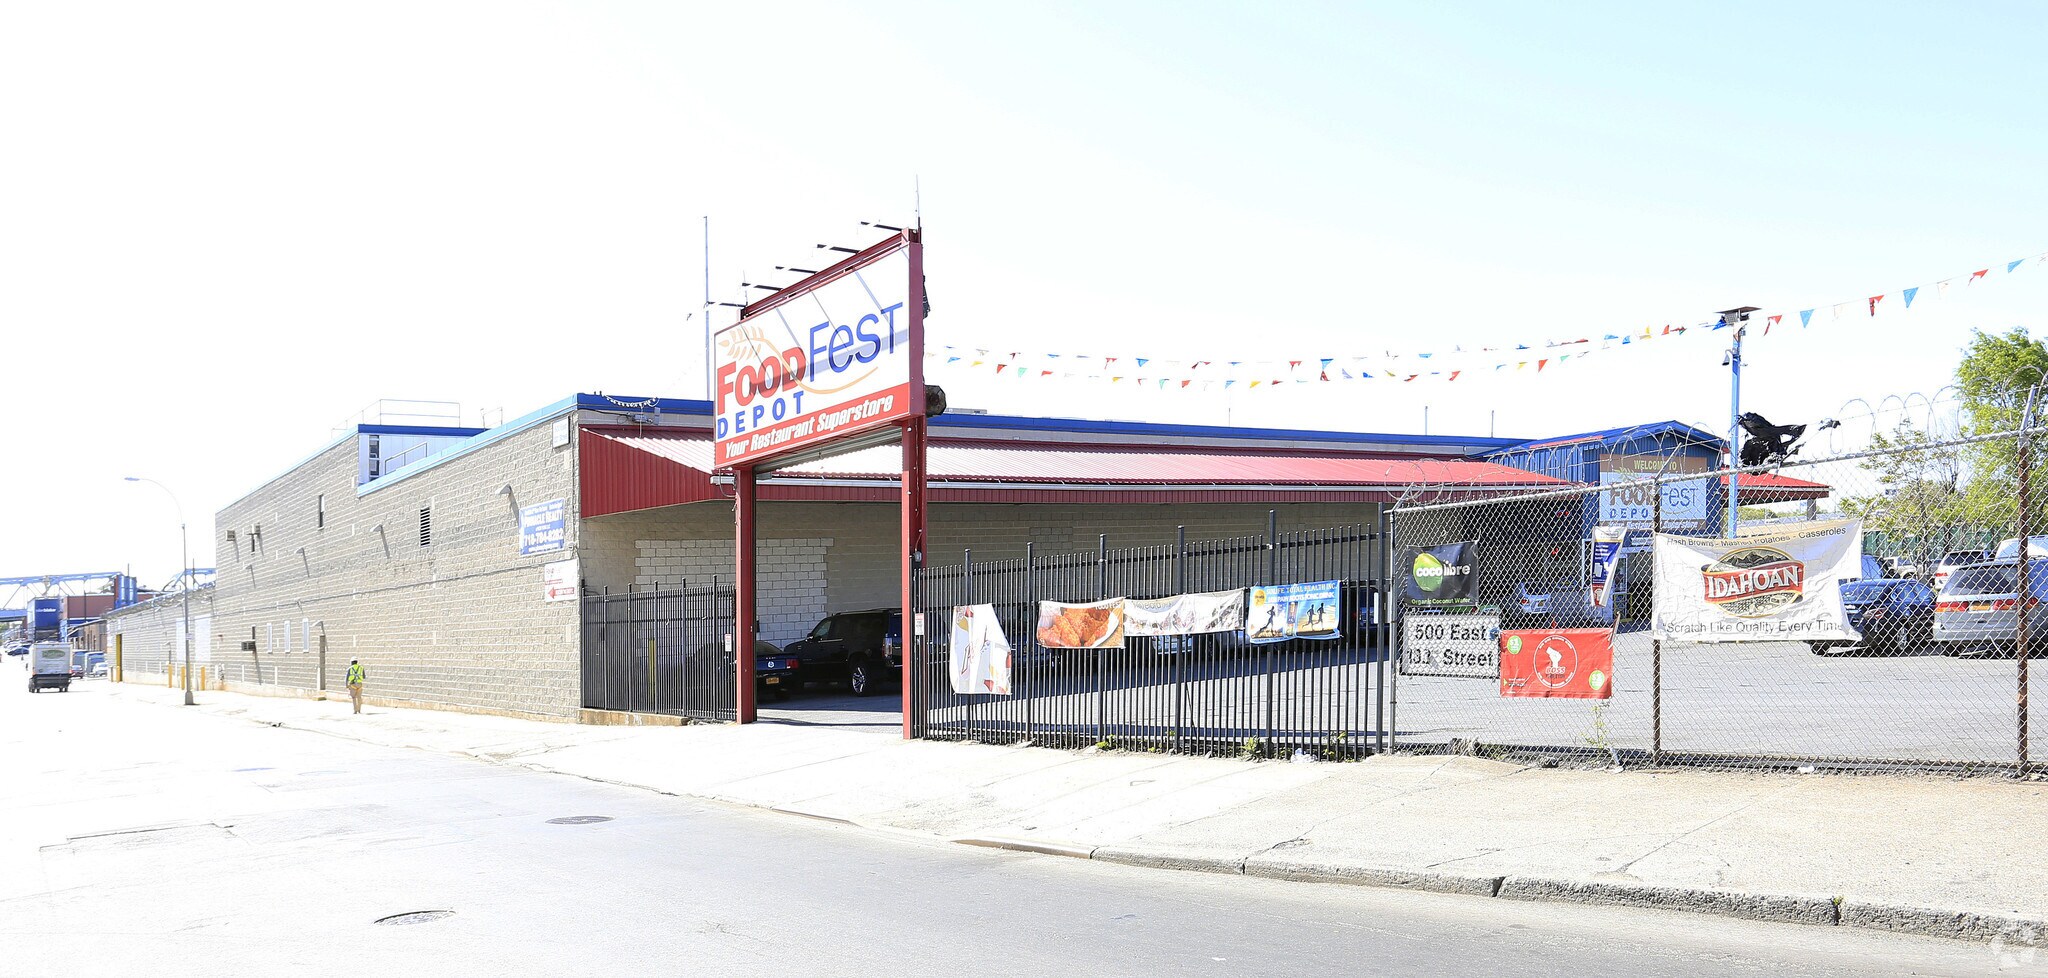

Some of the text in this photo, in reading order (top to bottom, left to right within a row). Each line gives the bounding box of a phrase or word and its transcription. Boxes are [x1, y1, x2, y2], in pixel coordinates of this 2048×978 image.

[717, 391, 804, 440] DEPOT
[725, 394, 894, 459] Your Restaurant Superstore
[1634, 459, 1677, 471] WELCOM TO
[1609, 507, 1649, 519] DEPO
[1689, 538, 1714, 547] Browns
[1798, 527, 1847, 540] Casseroles
[1706, 565, 1800, 599] IDAHOAN
[1411, 597, 1432, 606] Organic
[1432, 597, 1454, 605] Coconut
[1415, 623, 1487, 641] 500 East
[1709, 621, 1733, 633] Like
[1735, 621, 1774, 634] Quality
[1778, 620, 1813, 632] Every
[1443, 648, 1494, 667] Street
